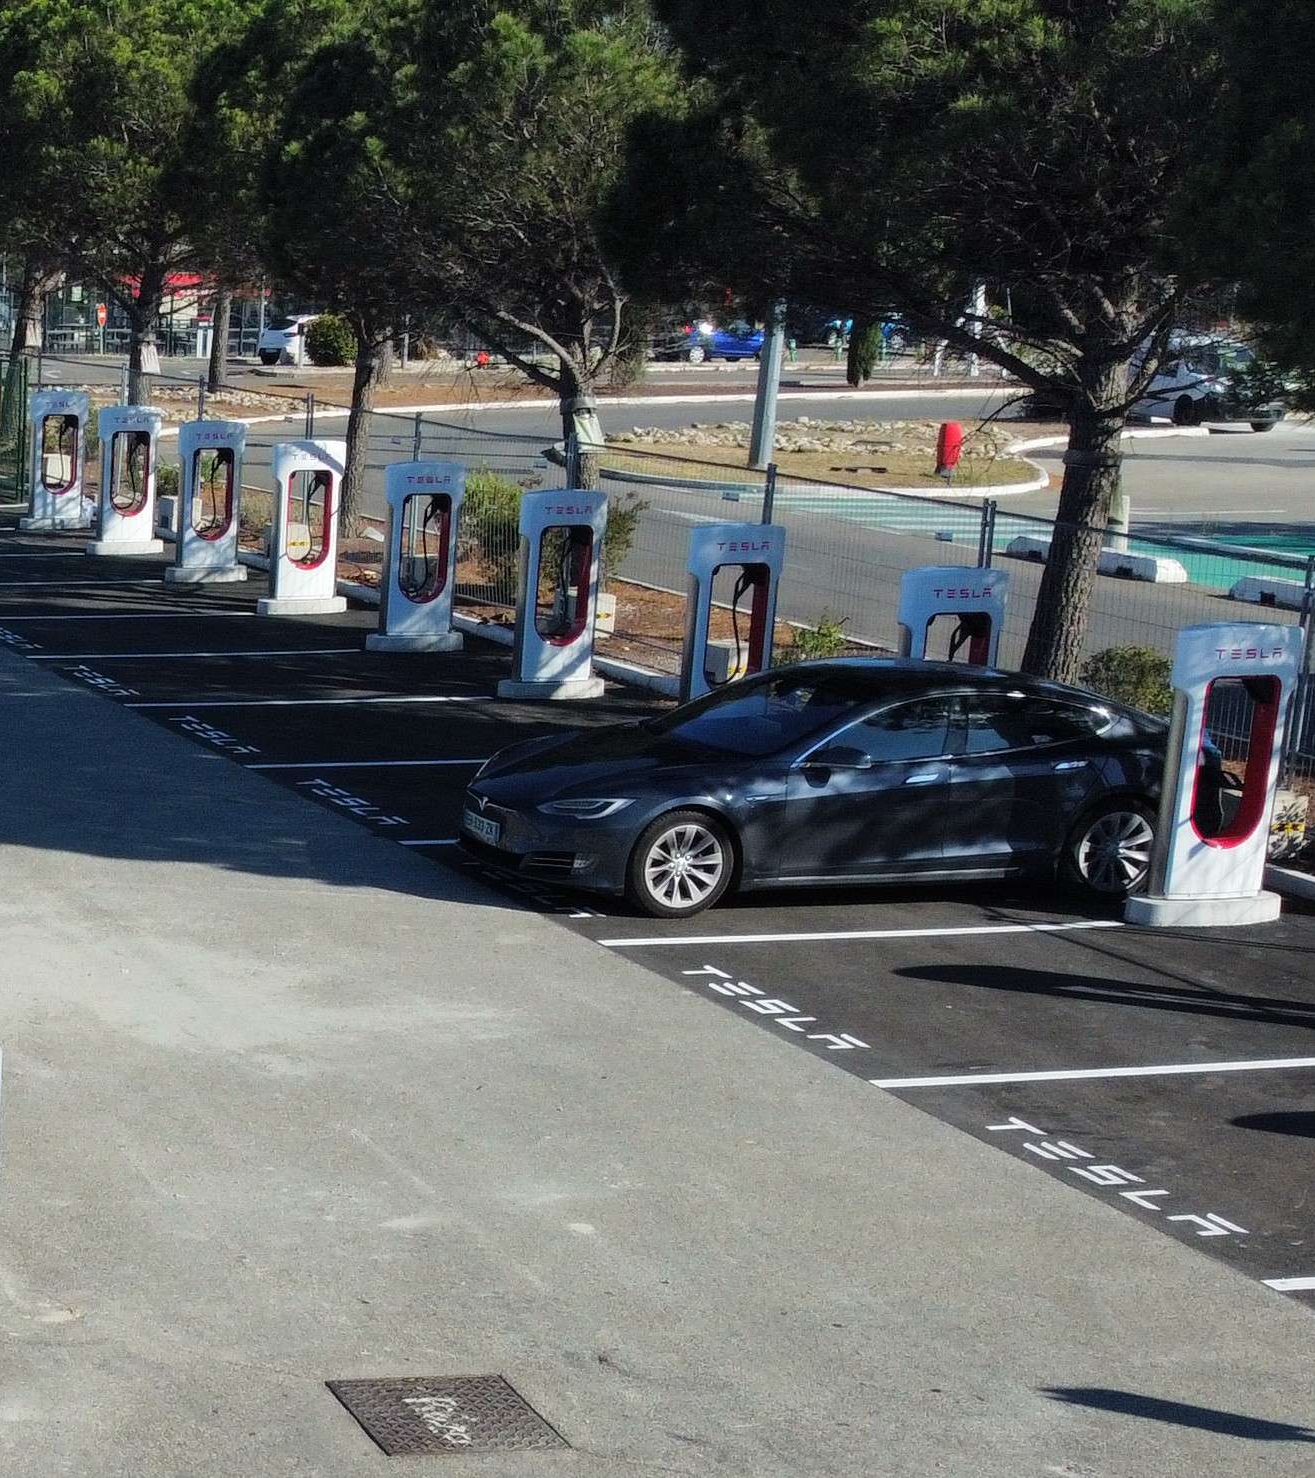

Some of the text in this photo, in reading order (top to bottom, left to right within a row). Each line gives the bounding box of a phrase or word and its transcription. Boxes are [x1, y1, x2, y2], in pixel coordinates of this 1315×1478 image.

[407, 475, 451, 484] TESLA
[545, 505, 593, 514] TESLA
[717, 541, 770, 551] TESLA
[933, 588, 992, 598] TESLA
[1215, 647, 1283, 660] TESLA
[169, 715, 261, 754] TESLA
[296, 778, 410, 825] TESLA
[681, 964, 872, 1050] TESLA
[984, 1116, 1251, 1237] TESLA
